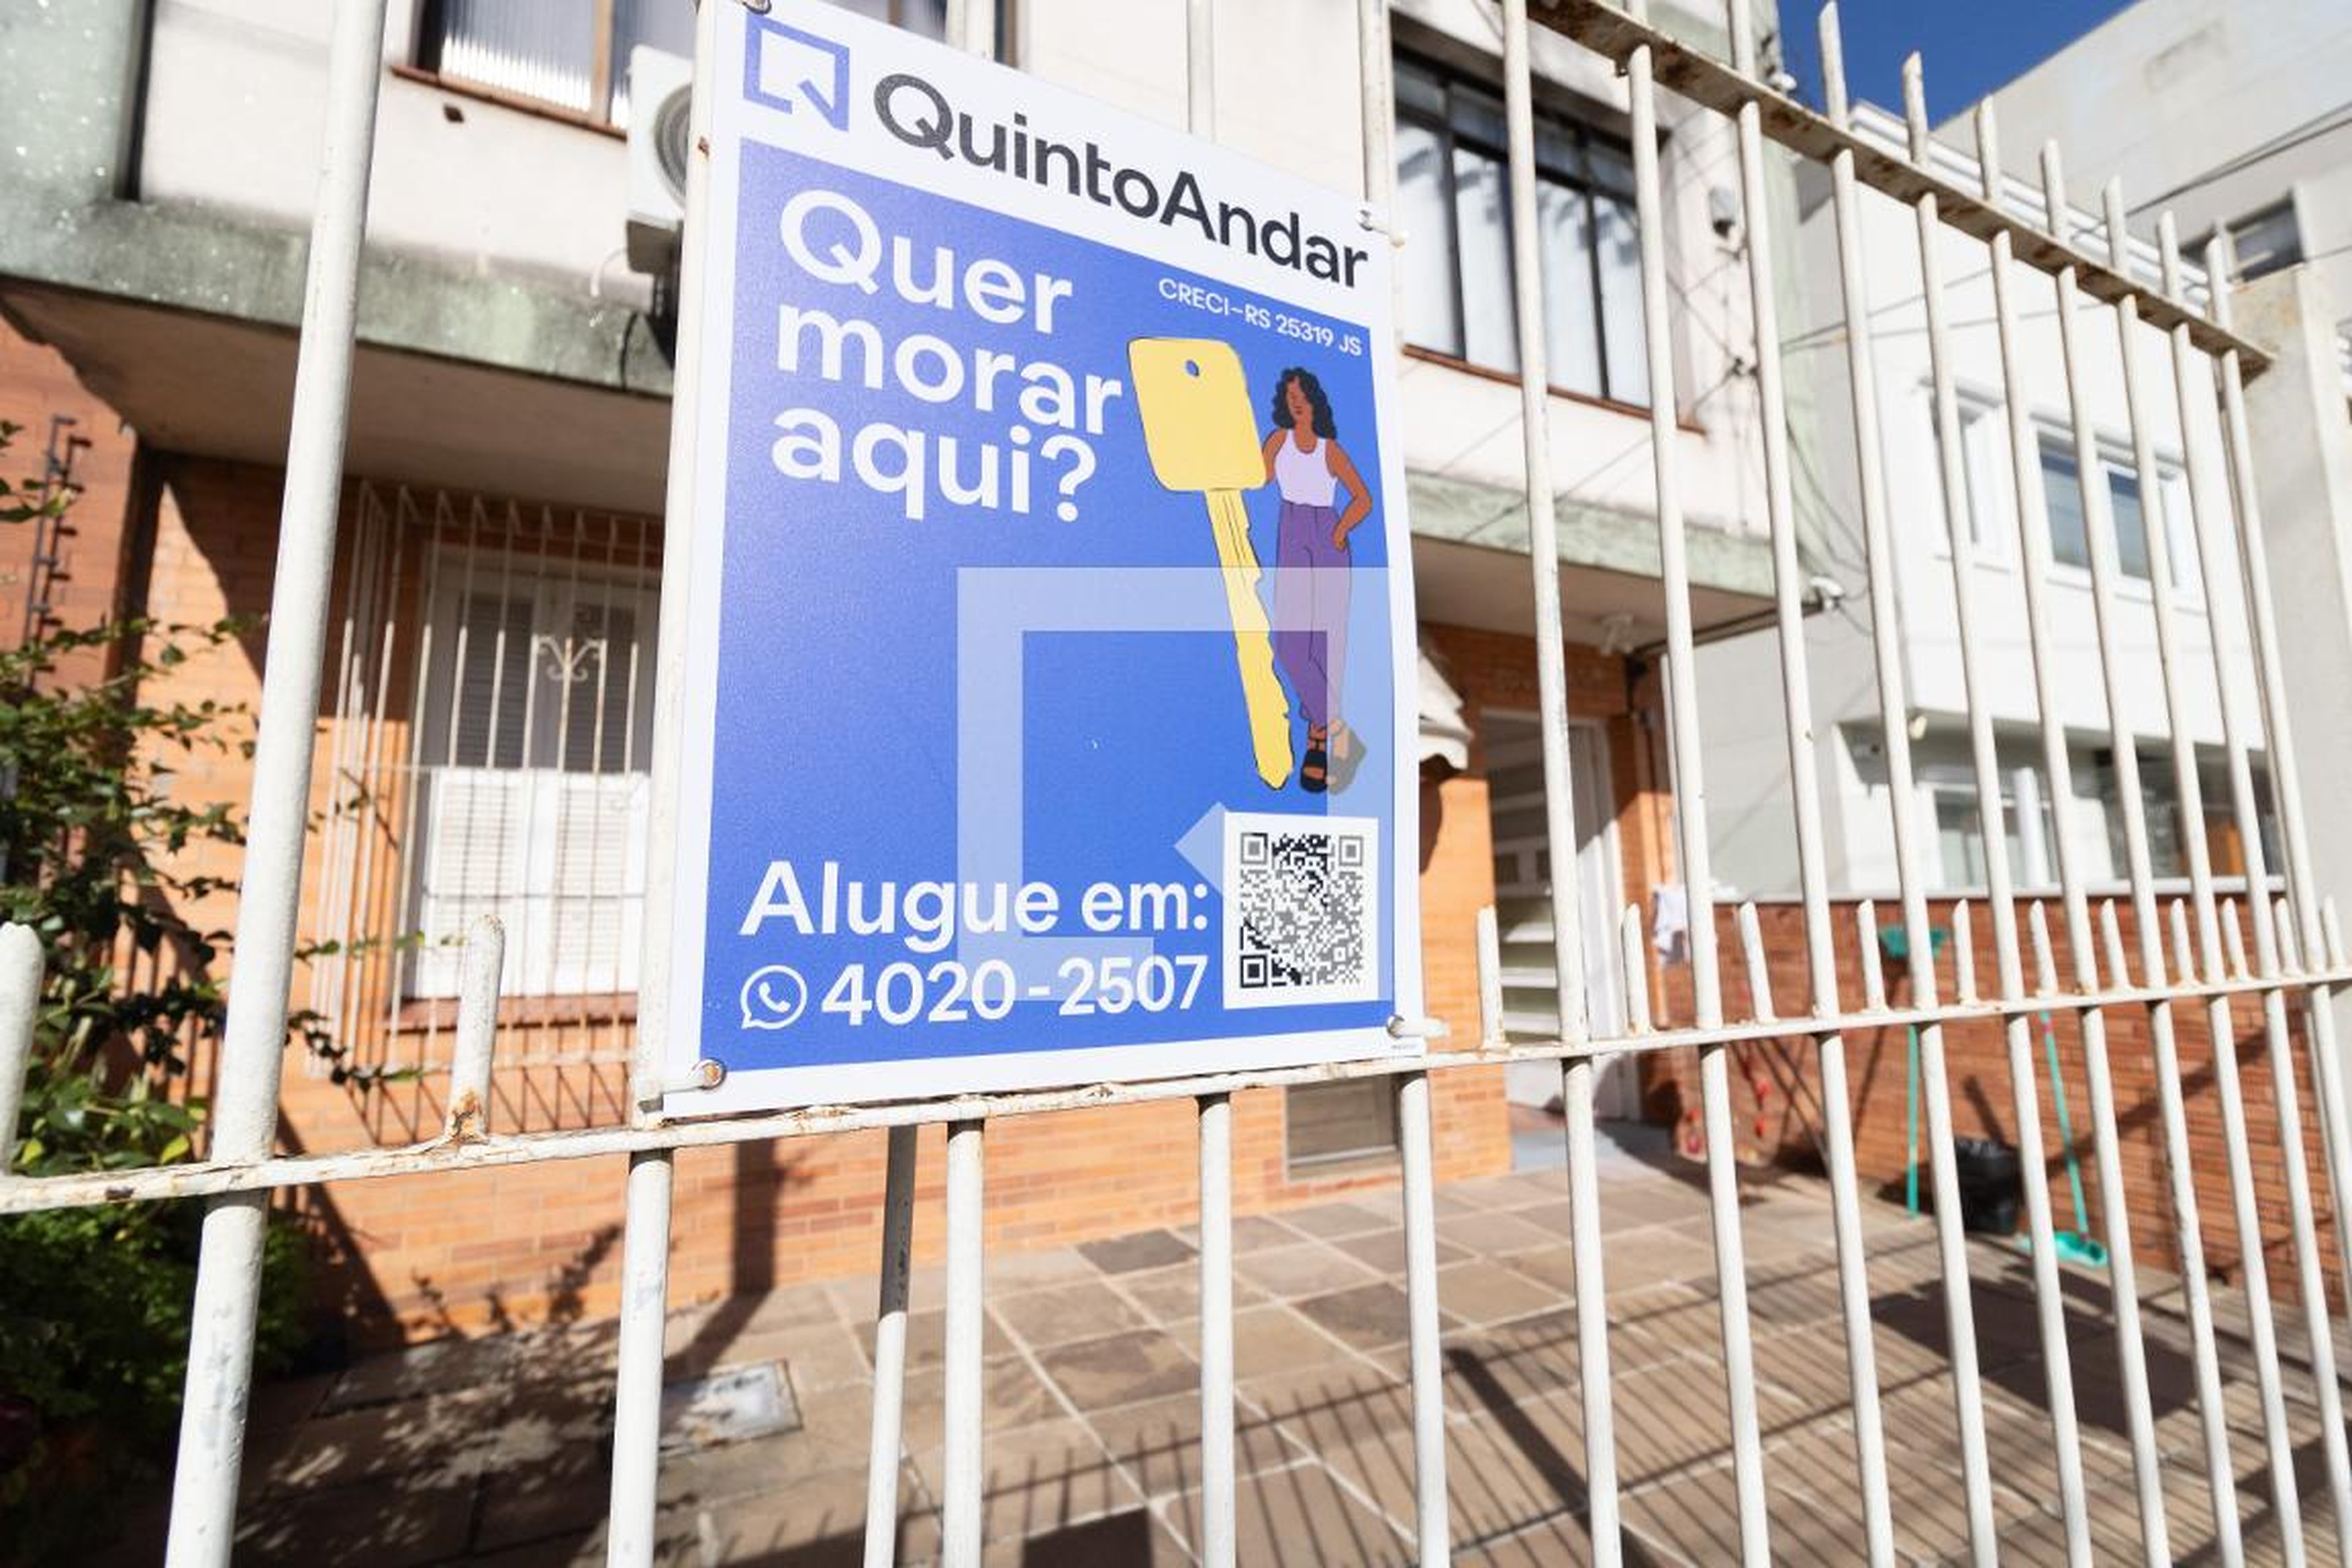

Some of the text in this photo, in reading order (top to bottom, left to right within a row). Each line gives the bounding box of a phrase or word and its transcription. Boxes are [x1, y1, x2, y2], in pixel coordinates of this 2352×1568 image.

[874, 73, 1368, 288] QuintoAndar
[778, 189, 1072, 334] Quer
[1158, 277, 1362, 356] CRECI-RS 25319 JS
[775, 303, 1122, 434] morar
[770, 407, 1096, 522] aqui?
[740, 861, 1207, 954] Alugue em:
